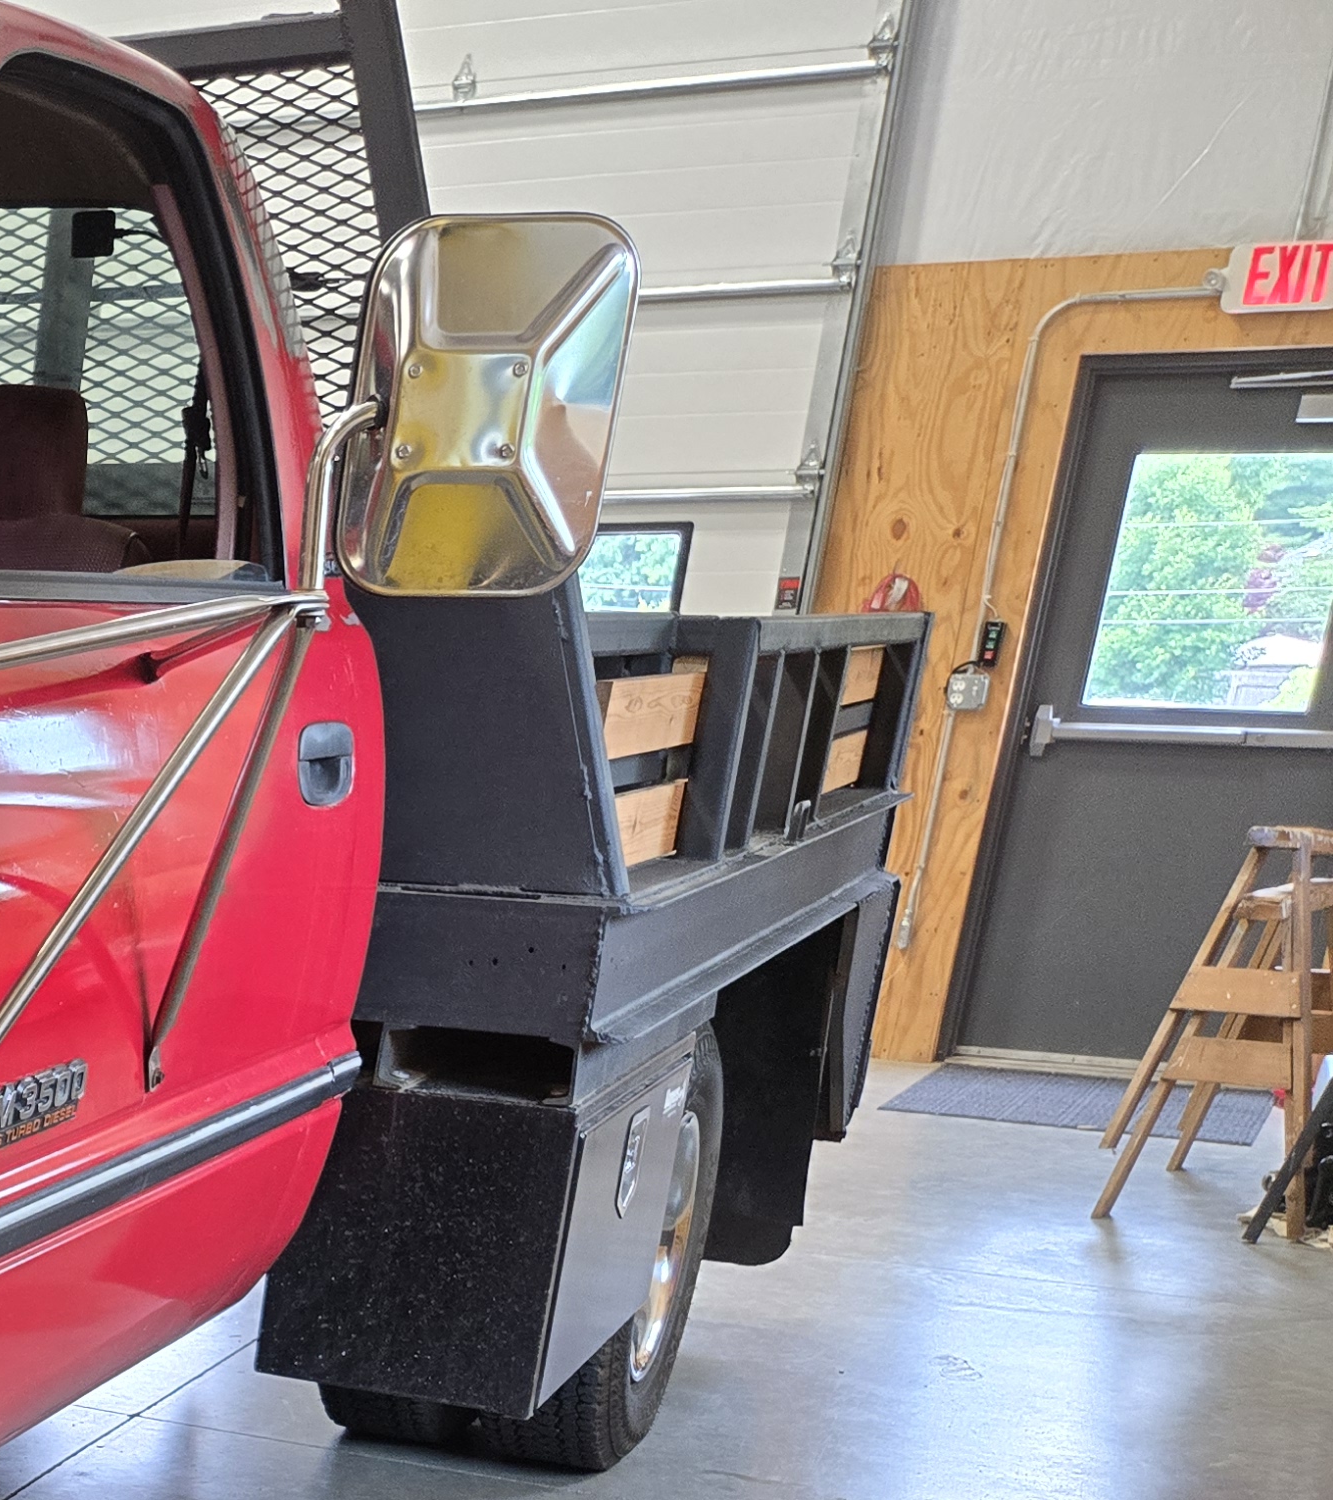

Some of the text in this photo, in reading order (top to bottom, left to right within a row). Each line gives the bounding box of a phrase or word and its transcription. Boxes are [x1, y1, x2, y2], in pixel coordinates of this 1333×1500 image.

[1242, 243, 1333, 305] EXIT
[17, 1059, 88, 1119] 3500
[5, 1118, 41, 1143] TURBO
[43, 1105, 77, 1128] DIESEL
